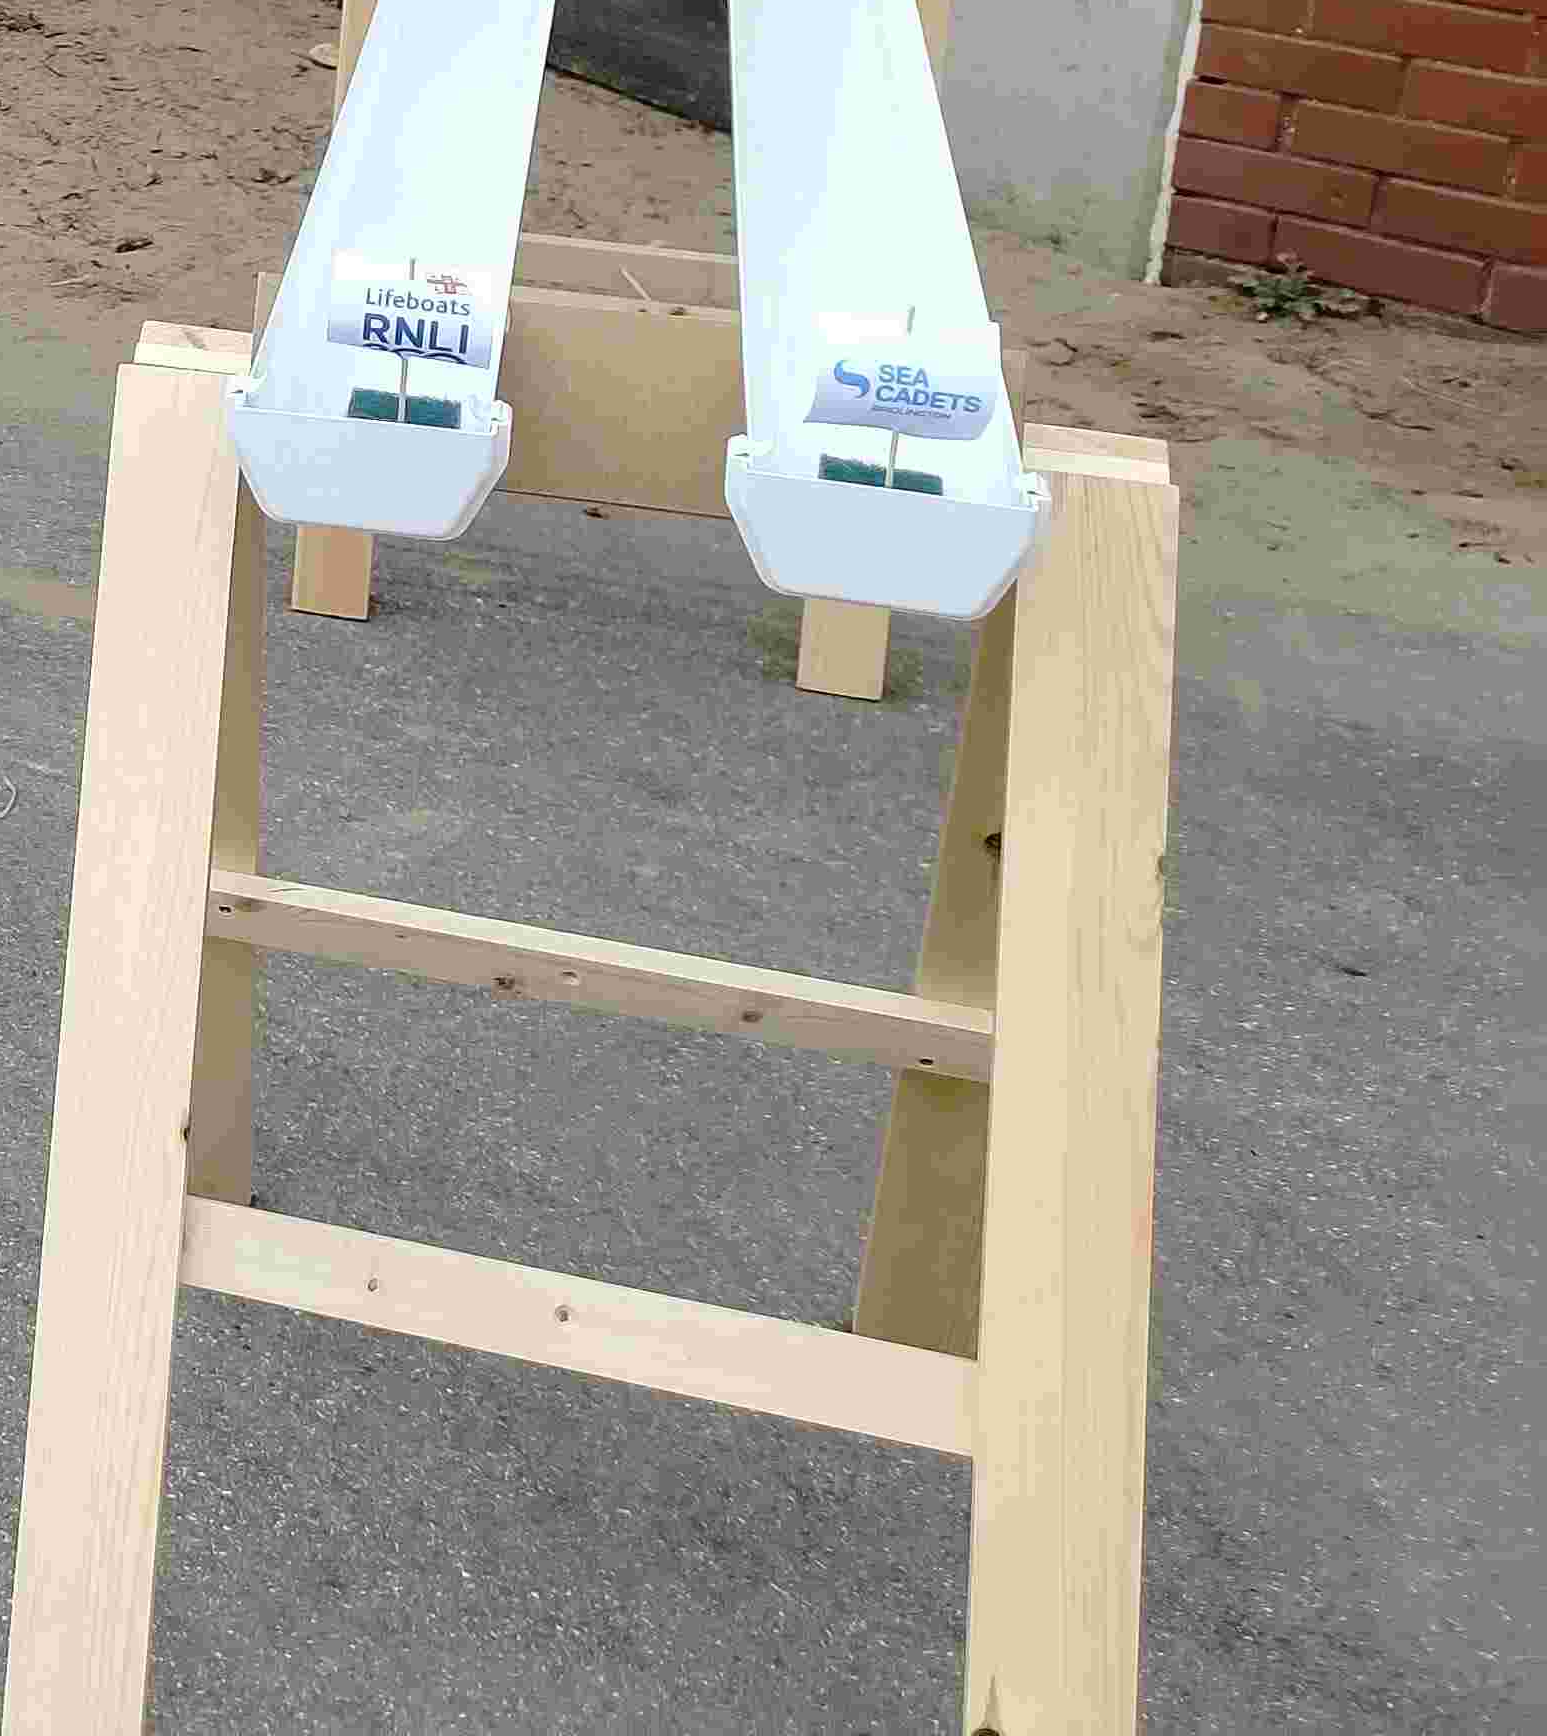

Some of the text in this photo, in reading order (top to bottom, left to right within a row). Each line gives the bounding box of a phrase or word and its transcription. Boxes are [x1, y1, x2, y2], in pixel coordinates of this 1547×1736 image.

[365, 287, 470, 316] Lifeboats
[362, 313, 469, 355] RNLI
[878, 364, 929, 388] SEA
[875, 385, 983, 412] CADETS
